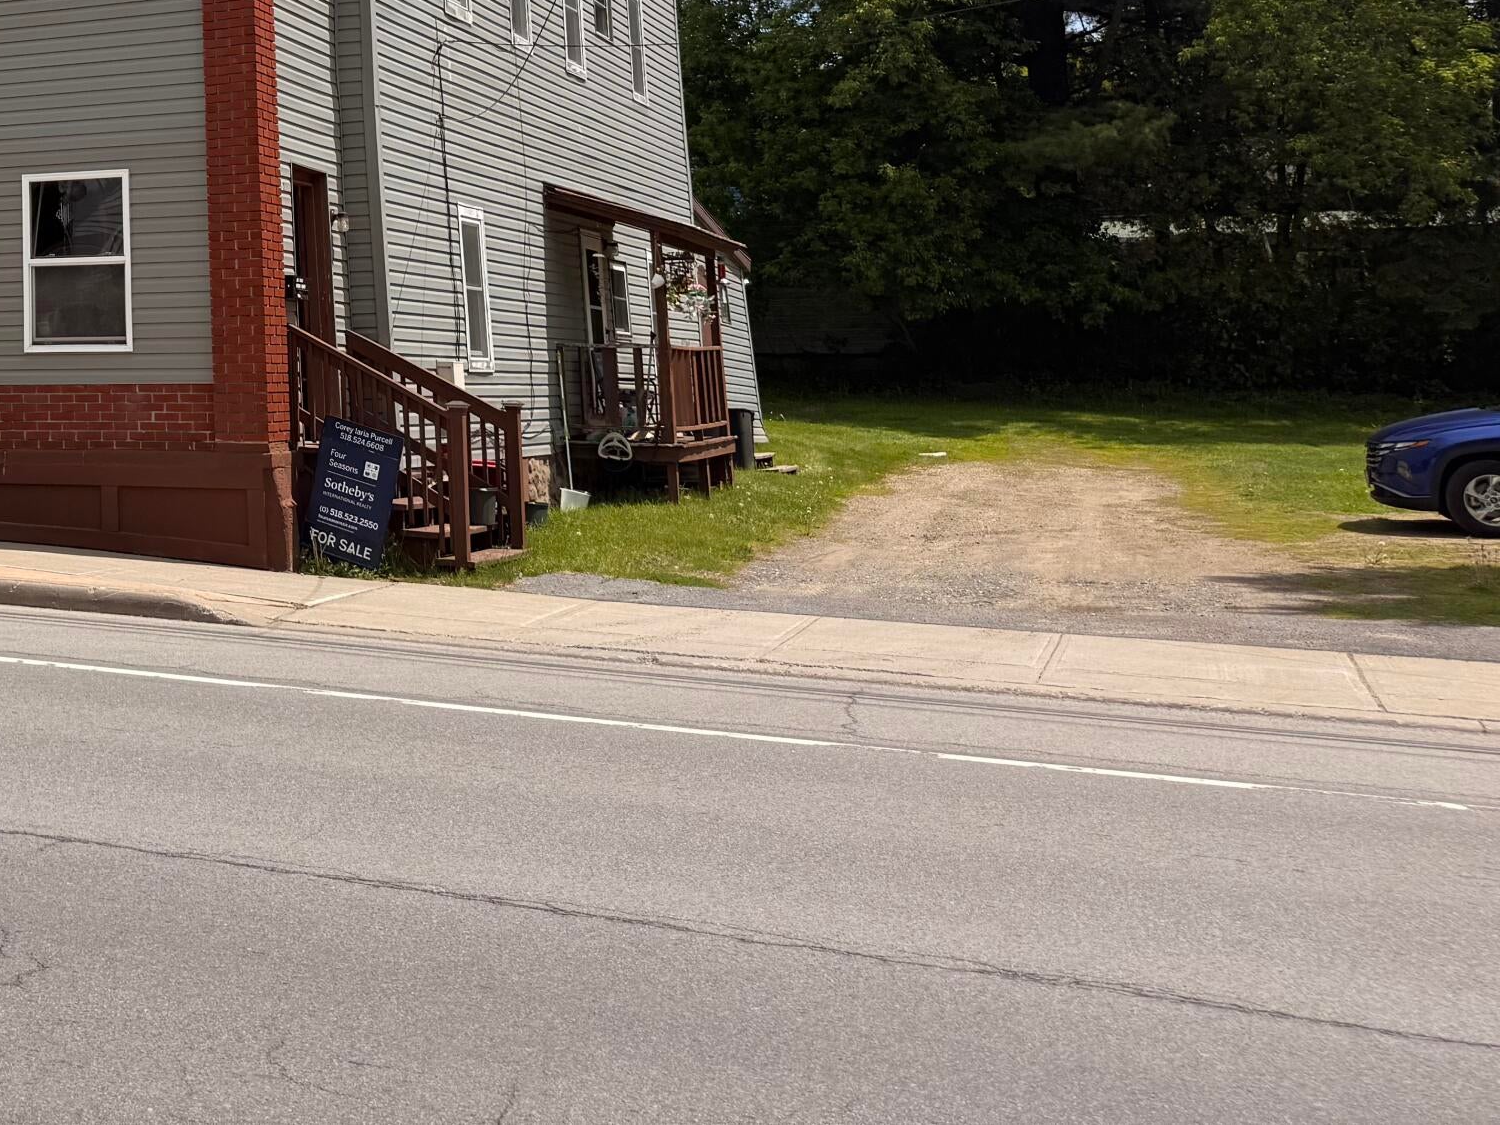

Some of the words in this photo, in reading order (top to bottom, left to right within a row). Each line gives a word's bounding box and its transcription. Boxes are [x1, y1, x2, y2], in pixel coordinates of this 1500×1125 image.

[335, 421, 354, 434] Corey
[370, 432, 394, 445] Purcell
[339, 432, 385, 452] 518.524.6608
[330, 448, 347, 460] Four
[328, 458, 359, 475] Seasons
[324, 477, 375, 502] Sotheby's
[329, 507, 379, 531] 518.523.2550
[311, 528, 337, 548] FOR
[338, 538, 373, 561] SALE
